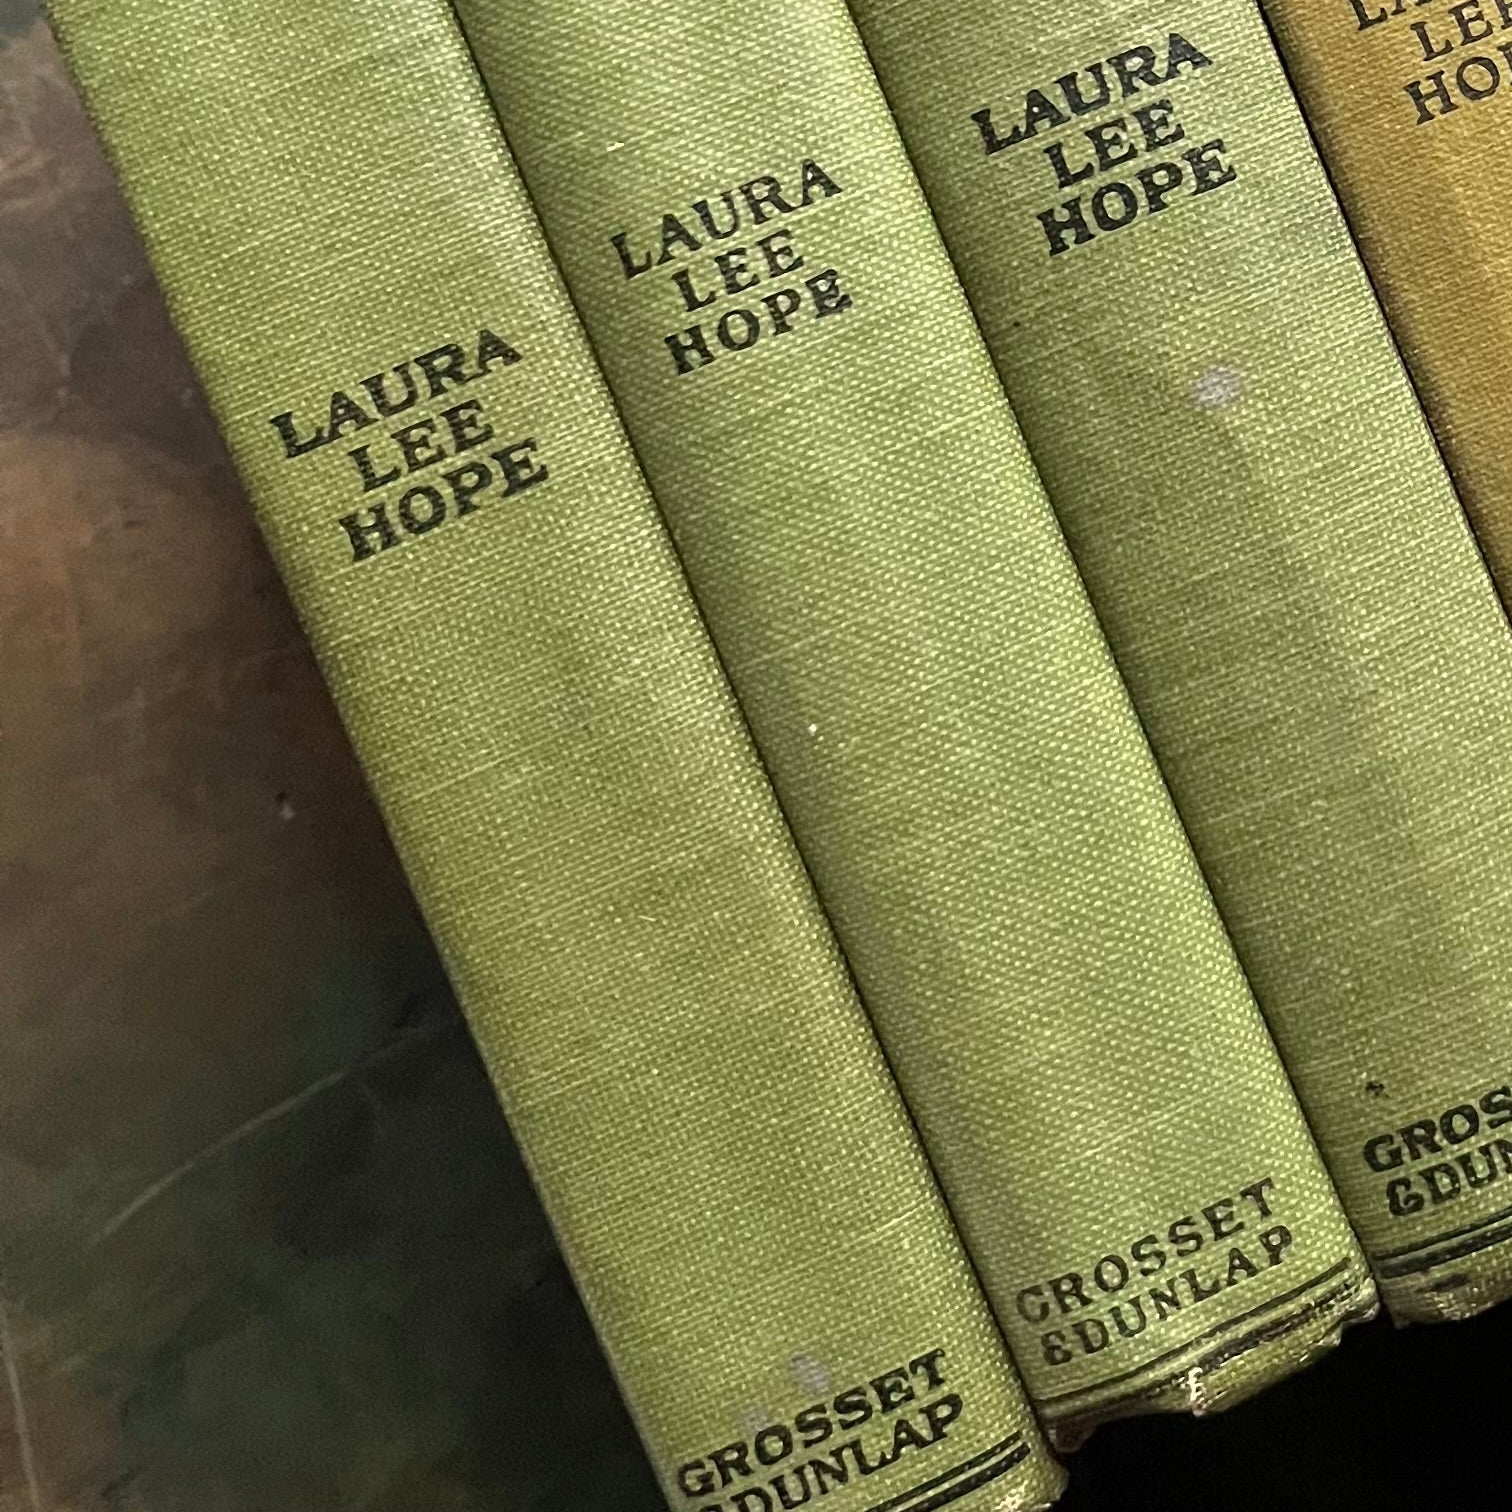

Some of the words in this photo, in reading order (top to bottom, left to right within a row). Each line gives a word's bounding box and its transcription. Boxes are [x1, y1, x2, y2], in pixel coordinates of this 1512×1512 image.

[971, 33, 1213, 156] LAURA
[1043, 100, 1186, 189] LEE
[610, 158, 843, 279] LAURA
[1036, 138, 1238, 257] HOPE
[664, 269, 853, 376] HOPE
[671, 229, 804, 312] LEE
[269, 329, 523, 459] LAURA
[348, 399, 496, 493] LEE
[339, 438, 550, 563] HOPE
[1015, 1177, 1276, 1325] GROSSET
[675, 1348, 946, 1497] GROSSET
